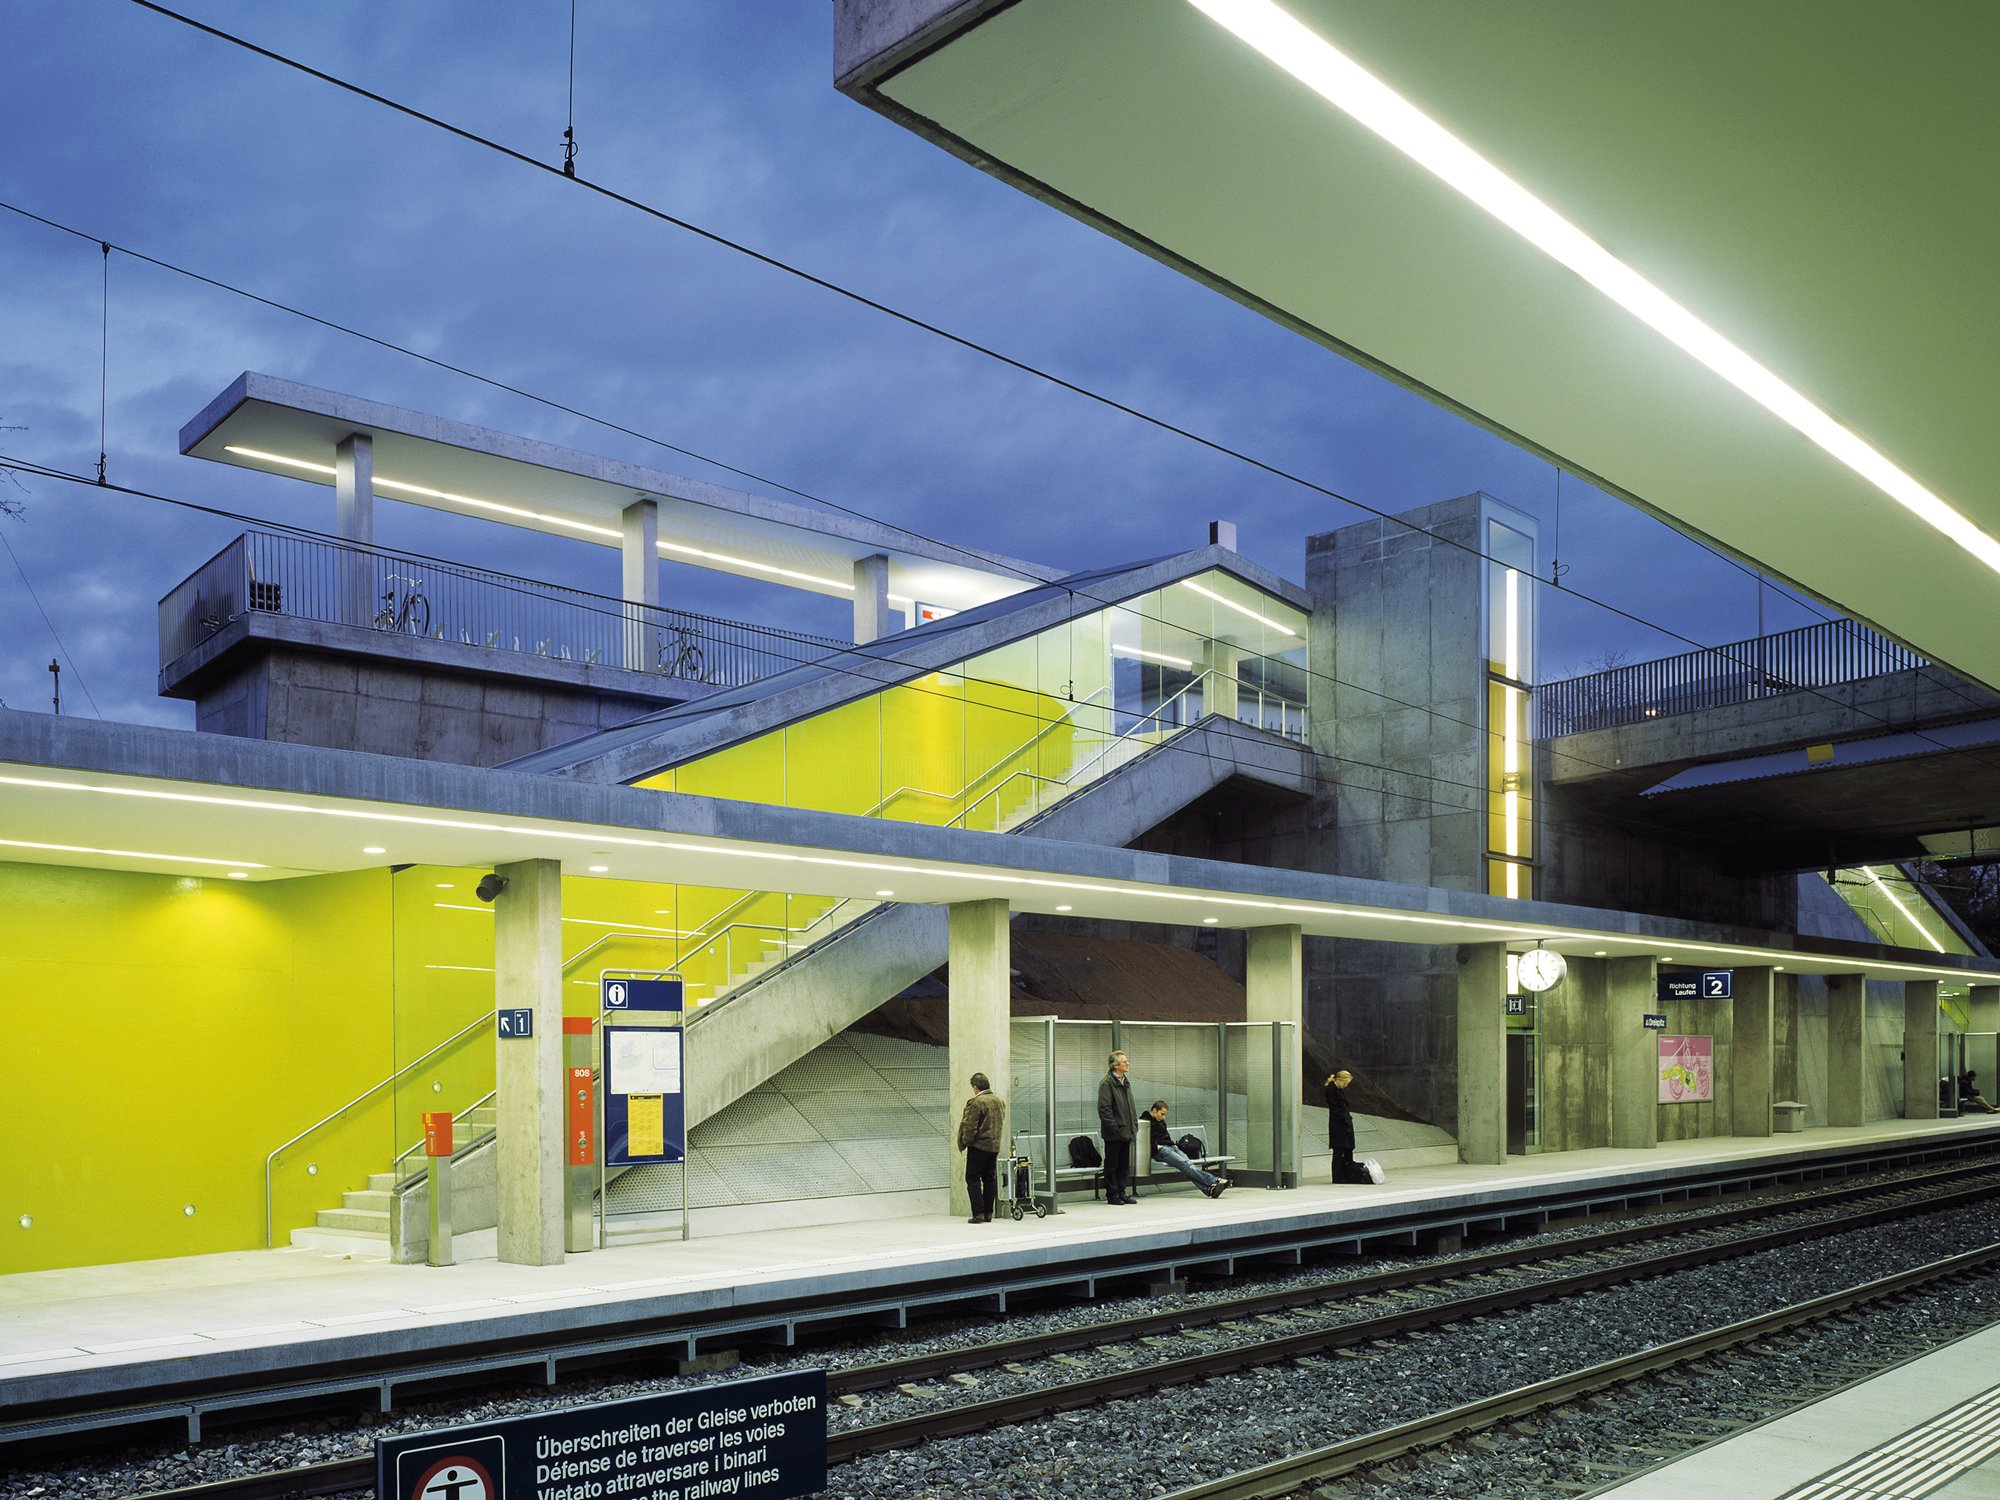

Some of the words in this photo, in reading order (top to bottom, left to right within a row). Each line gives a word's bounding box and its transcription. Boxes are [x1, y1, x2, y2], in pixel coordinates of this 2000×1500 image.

[1711, 980, 1723, 995] 2
[519, 1017, 524, 1032] 1
[574, 1069, 590, 1077] SOS
[536, 1421, 661, 1460] Überschreiten
[665, 1417, 694, 1436] der
[697, 1407, 747, 1430] Gleise
[750, 1395, 817, 1419] verboten
[536, 1456, 611, 1484] Défense
[615, 1450, 637, 1468] de
[641, 1436, 715, 1462] traverser
[719, 1431, 742, 1450] les
[745, 1422, 786, 1443] voies
[537, 1481, 602, 1500] Vietato
[606, 1460, 709, 1495] attraversare
[714, 1455, 719, 1472] i
[723, 1445, 767, 1471] binari
[652, 1489, 680, 1500] the
[684, 1476, 741, 1500] railway
[744, 1467, 780, 1488] lines
